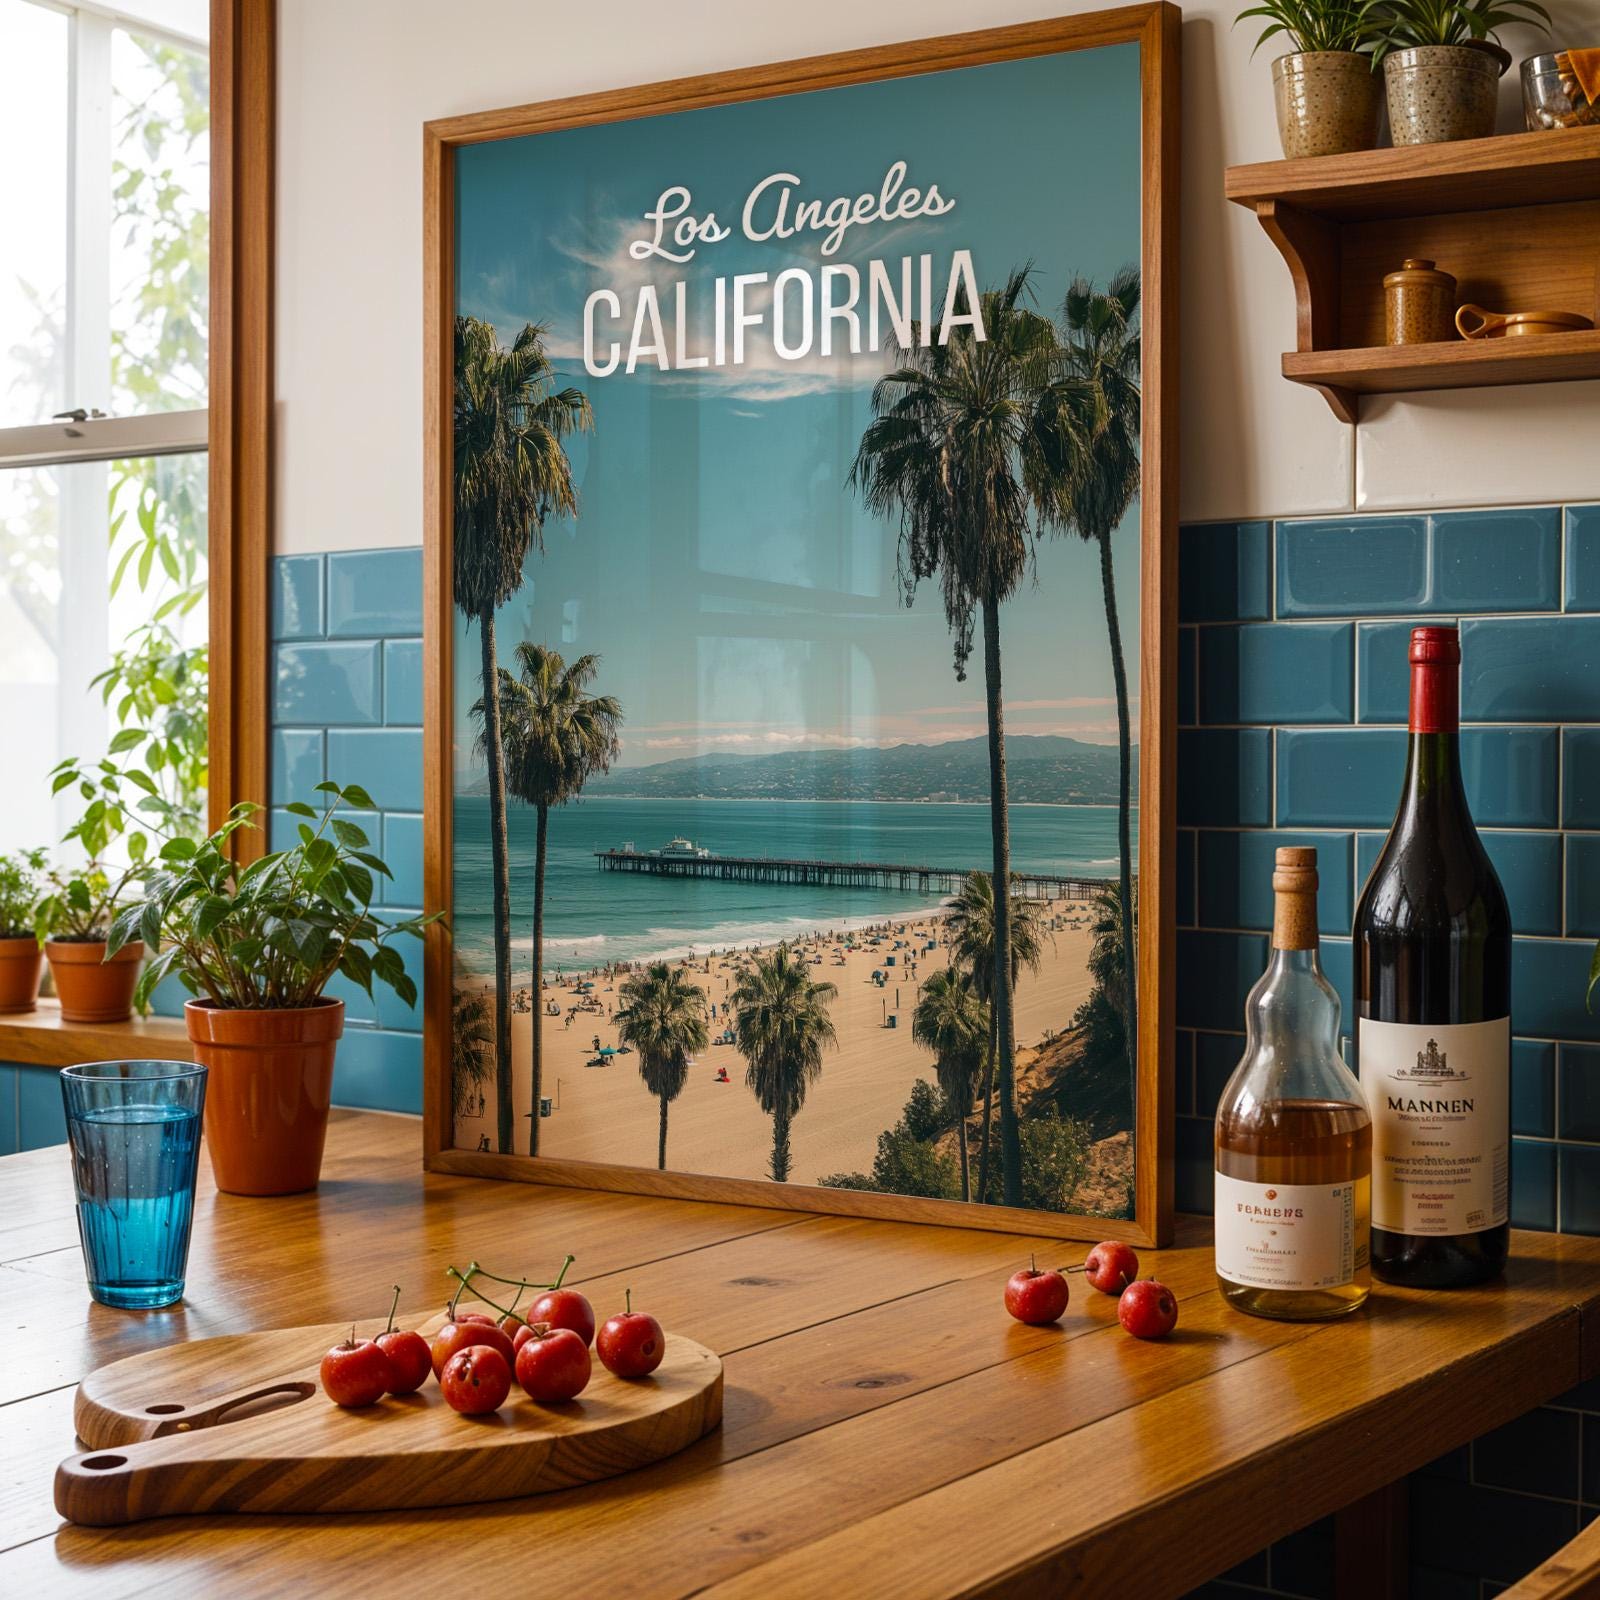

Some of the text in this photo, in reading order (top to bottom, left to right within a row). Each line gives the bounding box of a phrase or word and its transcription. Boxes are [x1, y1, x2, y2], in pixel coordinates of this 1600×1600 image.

[629, 160, 956, 263] Los Angeles
[583, 249, 987, 377] CALIFORNIA
[1388, 1096, 1474, 1113] MANNEN
